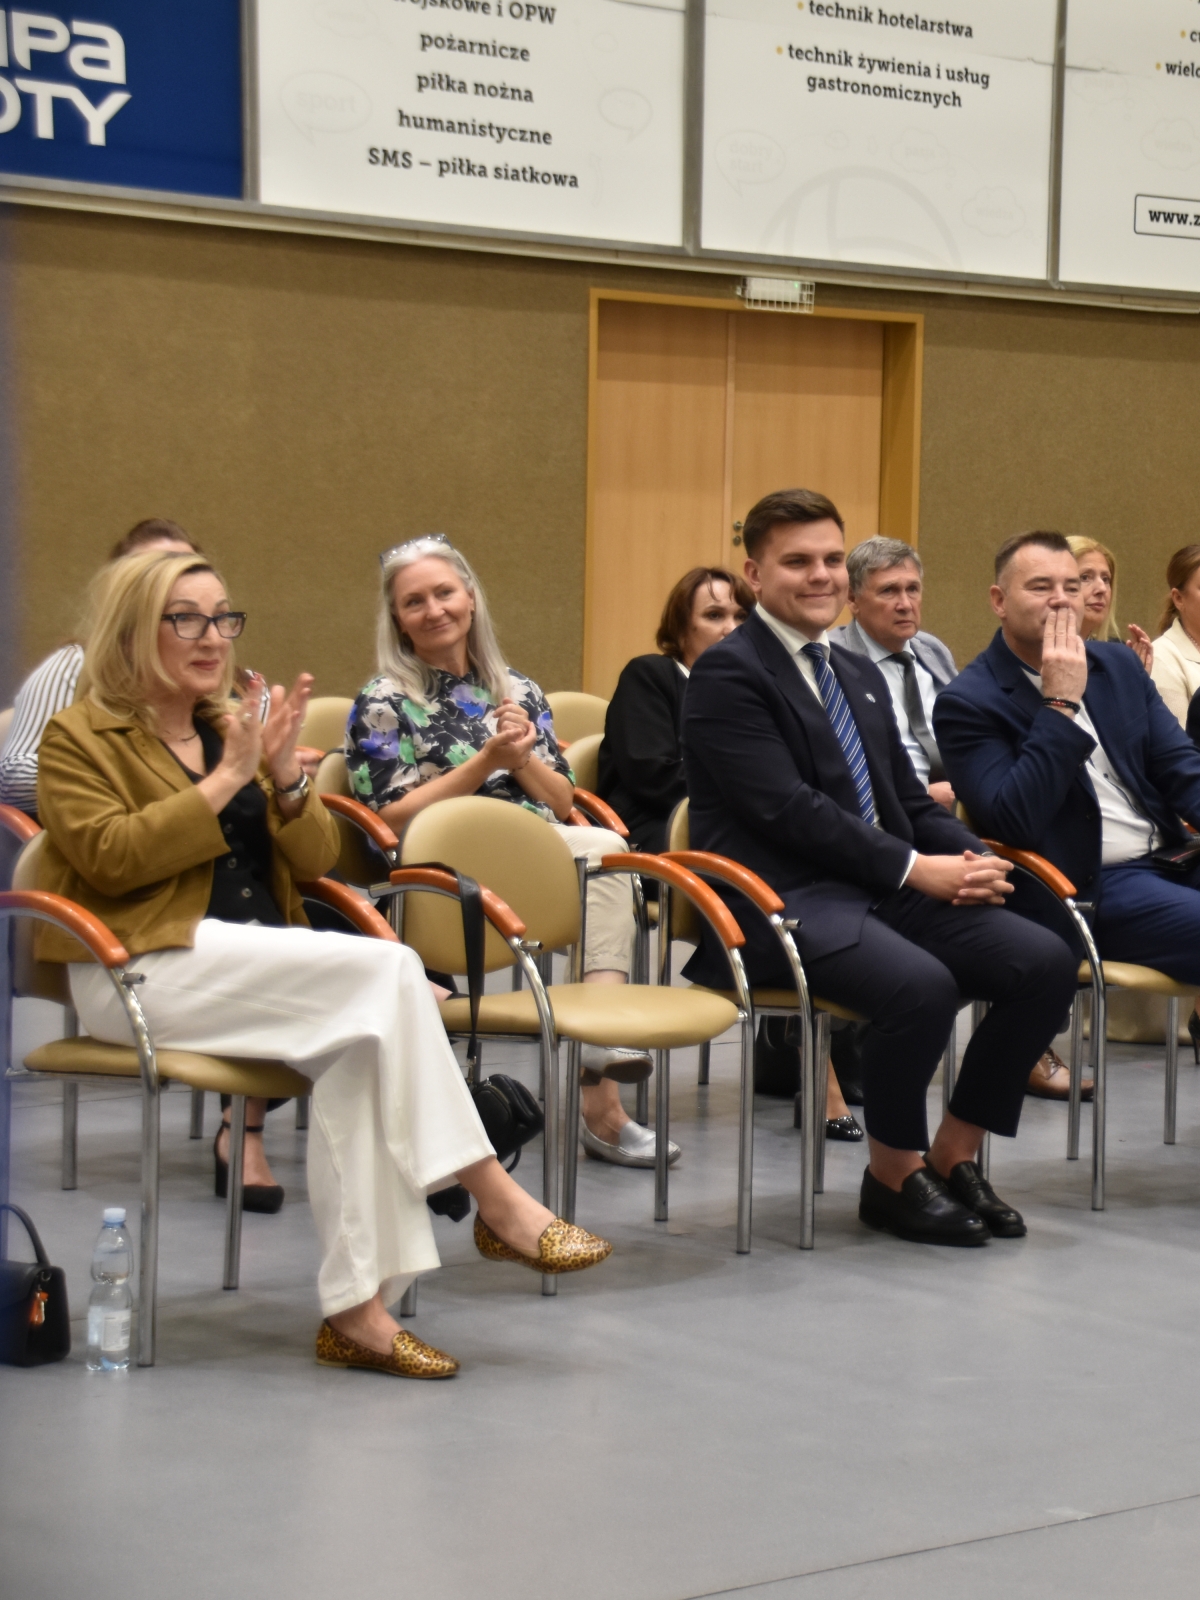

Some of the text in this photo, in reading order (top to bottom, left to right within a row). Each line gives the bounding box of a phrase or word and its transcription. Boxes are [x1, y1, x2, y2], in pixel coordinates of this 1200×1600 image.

[496, 1, 503, 17] i
[508, 1, 557, 25] OPW
[809, 0, 974, 39] technik hotelarstwa
[419, 32, 531, 62] pożarnicze
[787, 43, 991, 90] technik żywienia i usług
[416, 72, 534, 103] piłka nożna
[807, 74, 963, 109] gastronomicznych
[397, 108, 553, 146] humanistyczne
[367, 146, 413, 169] SMS
[437, 157, 488, 178] piłka
[493, 163, 579, 189] siatkowa
